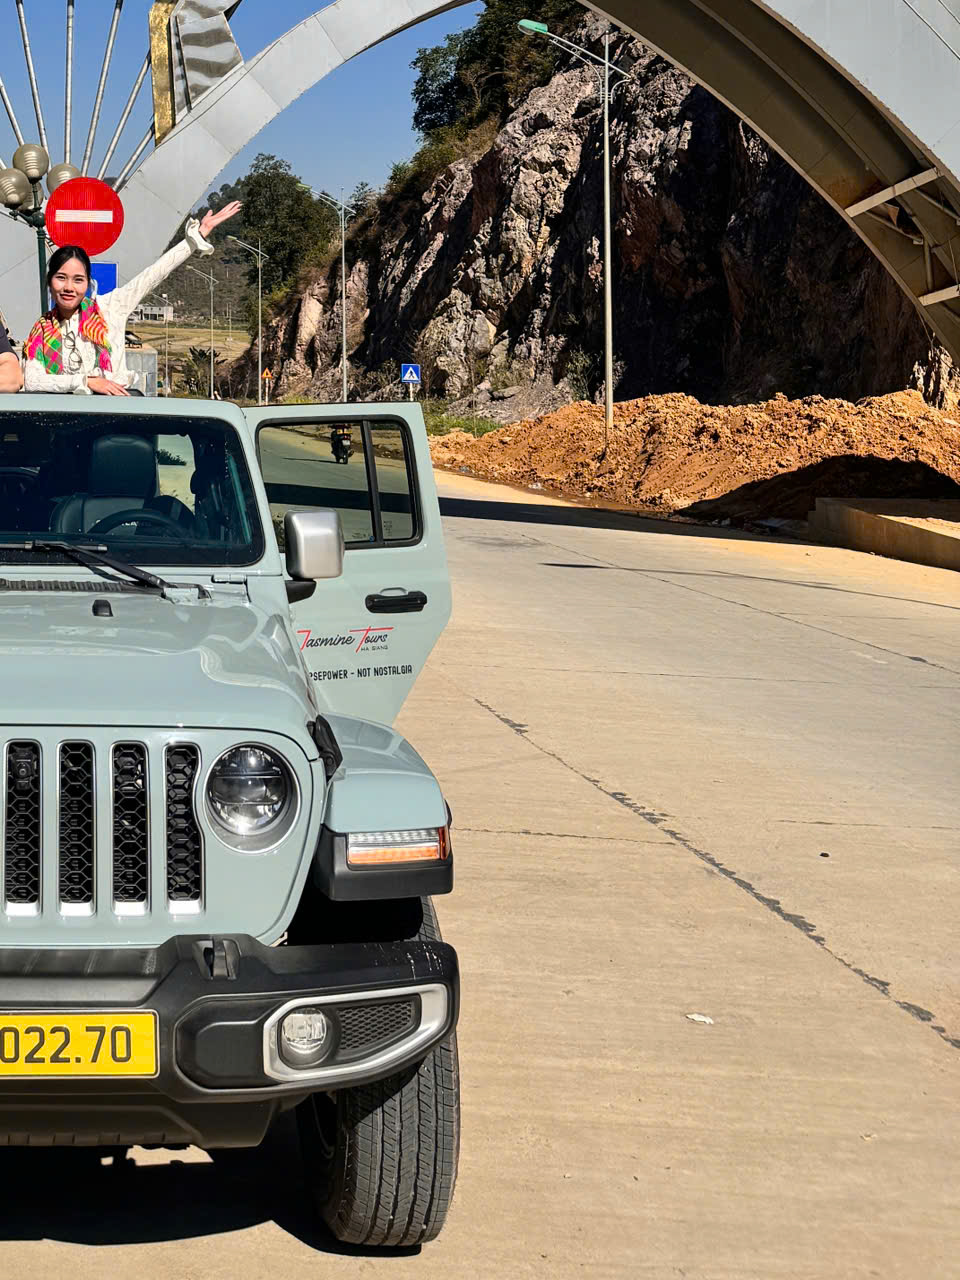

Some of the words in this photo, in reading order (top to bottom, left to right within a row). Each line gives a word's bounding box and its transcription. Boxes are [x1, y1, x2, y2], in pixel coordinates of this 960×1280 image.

[296, 629, 356, 652] Jasmine
[349, 626, 394, 653] Tours
[357, 667, 371, 678] NOT
[374, 664, 413, 677] NOSTALGIA
